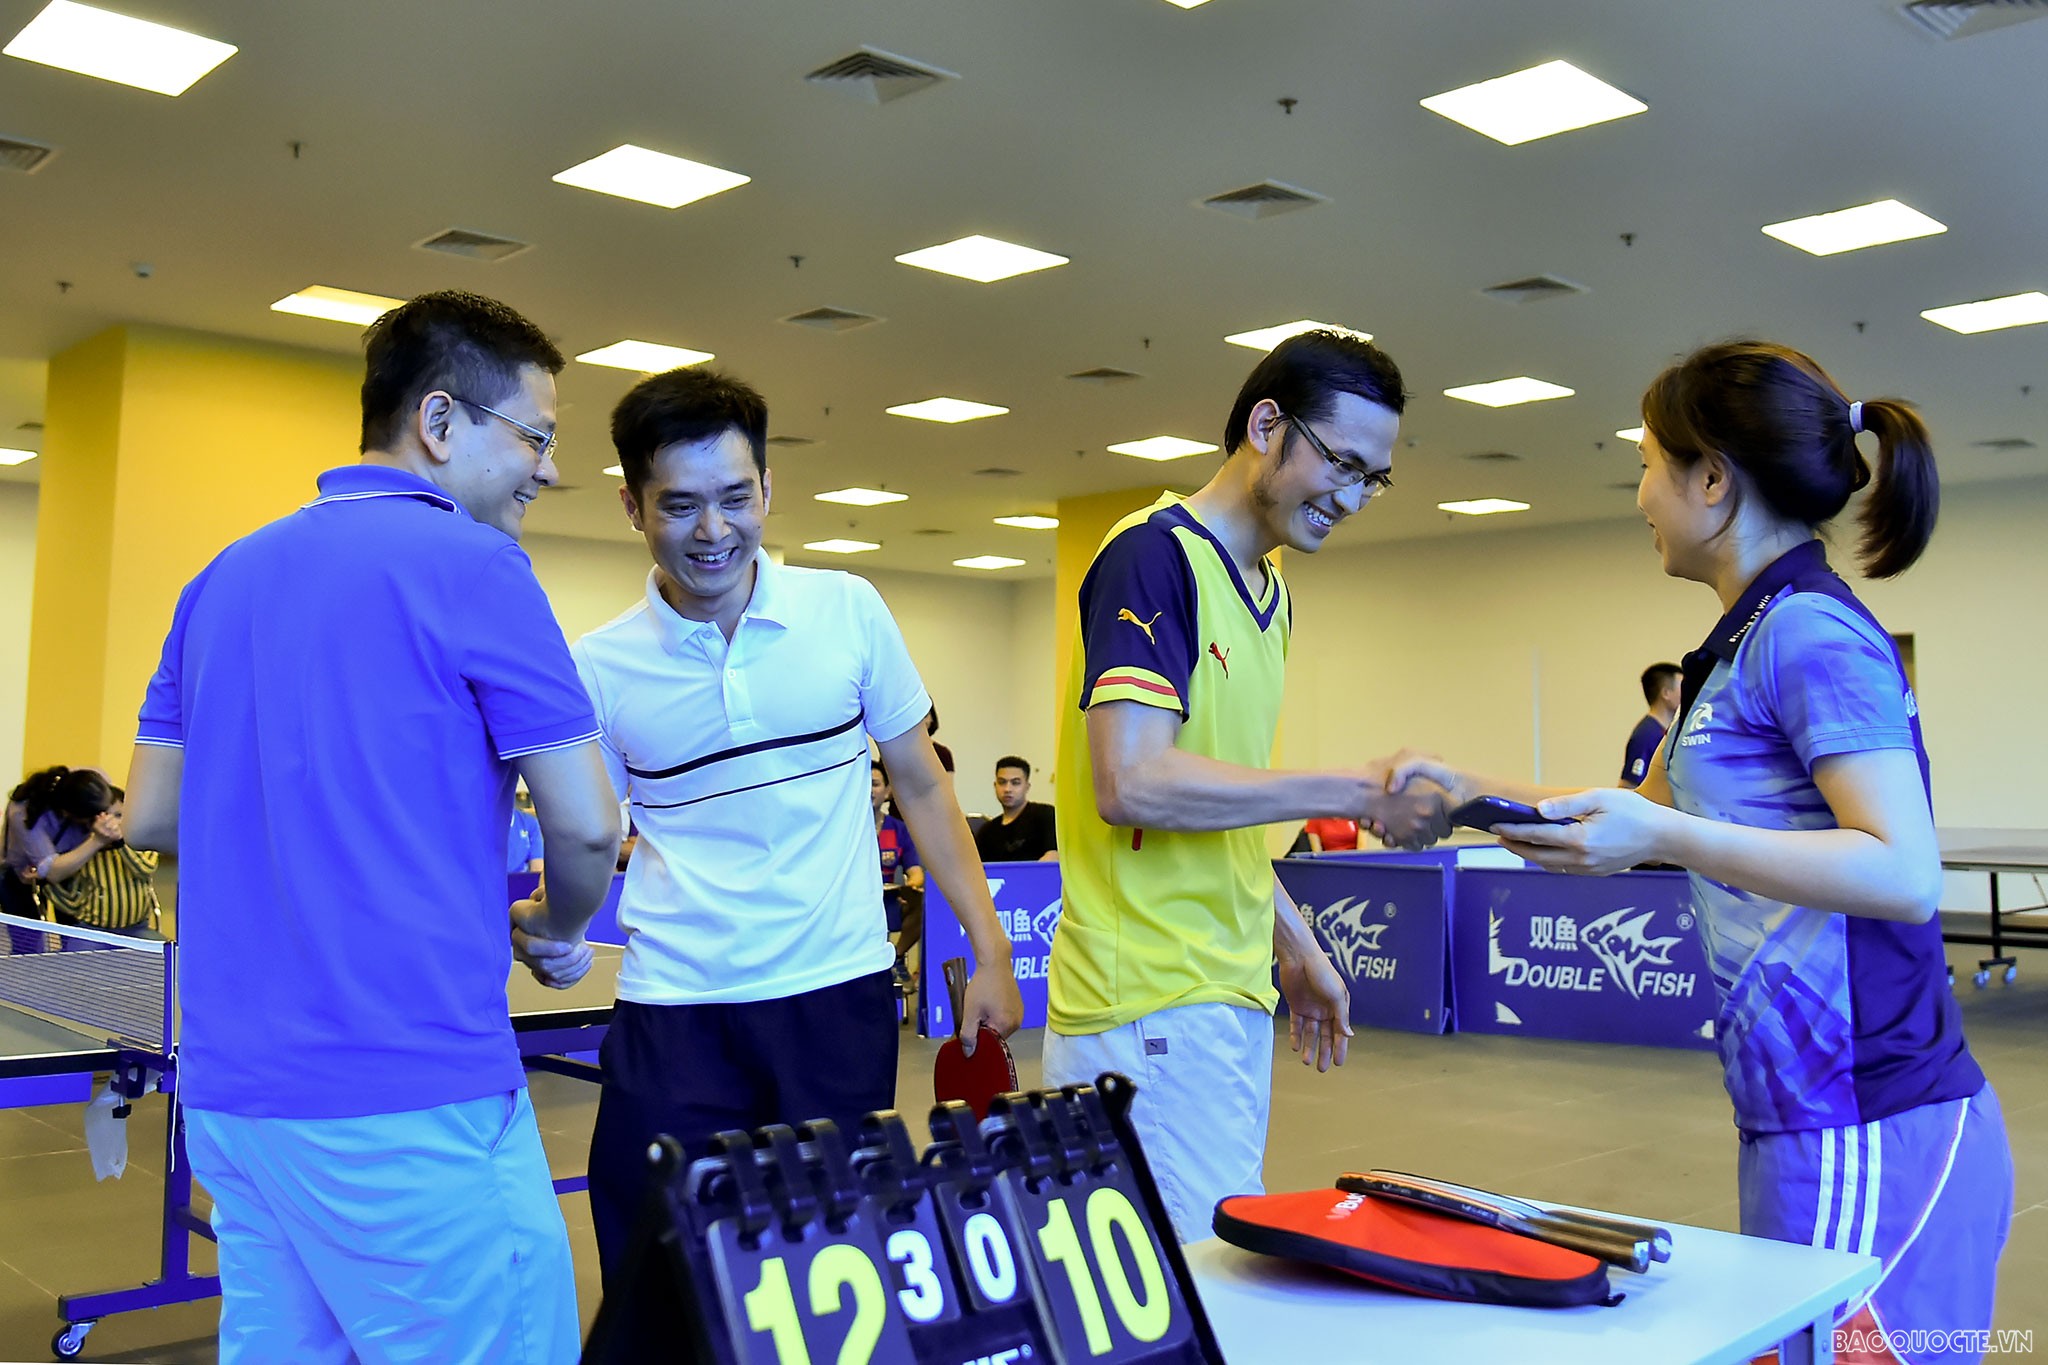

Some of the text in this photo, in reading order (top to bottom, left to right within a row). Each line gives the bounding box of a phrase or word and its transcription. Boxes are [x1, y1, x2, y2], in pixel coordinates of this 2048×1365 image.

[1681, 733, 1711, 746] SWIN
[1529, 915, 1579, 952] 双魚
[1355, 955, 1397, 980] FISH
[1505, 957, 1696, 998] DOUBLE FISH
[887, 1229, 944, 1322] 3
[963, 1212, 1017, 1303] 0
[1038, 1187, 1171, 1356] 10
[744, 1243, 886, 1365] 12
